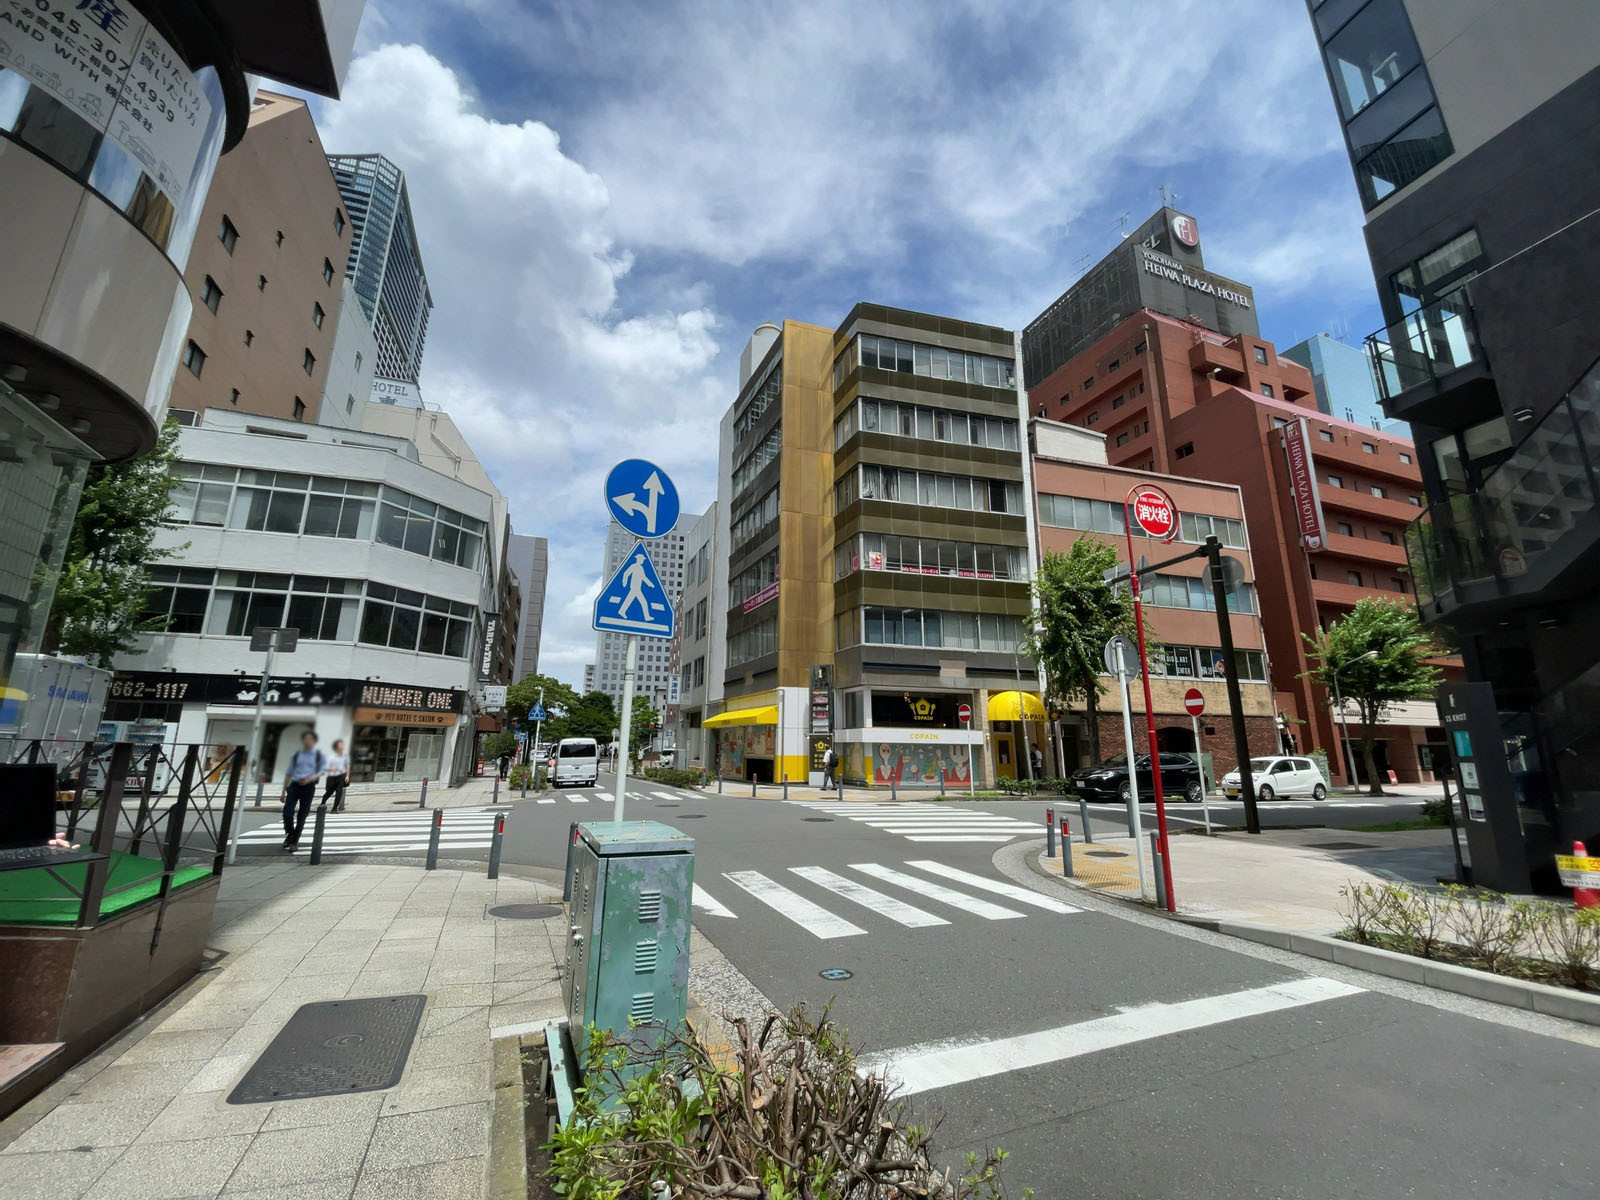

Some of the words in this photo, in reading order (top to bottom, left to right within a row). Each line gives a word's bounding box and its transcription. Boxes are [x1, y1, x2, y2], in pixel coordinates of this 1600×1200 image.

[0, 11, 45, 43] AND
[54, 43, 100, 83] WITH
[105, 83, 154, 134] 株式会社
[35, 0, 175, 123] 045-307-4939
[1142, 250, 1184, 272] YOKOHAMA
[1144, 261, 1181, 283] HEIWA
[1182, 274, 1216, 296] PLAZA
[1217, 287, 1250, 307] HOTEL
[1291, 440, 1303, 471] HEIWA
[1296, 469, 1309, 499] PLAZA
[1138, 504, 1170, 524] 消火栓
[1302, 499, 1315, 531] HOTEL
[486, 620, 496, 644] TARP
[482, 650, 492, 675] TARP
[361, 685, 424, 708] NUMBER
[427, 691, 453, 709] ONE
